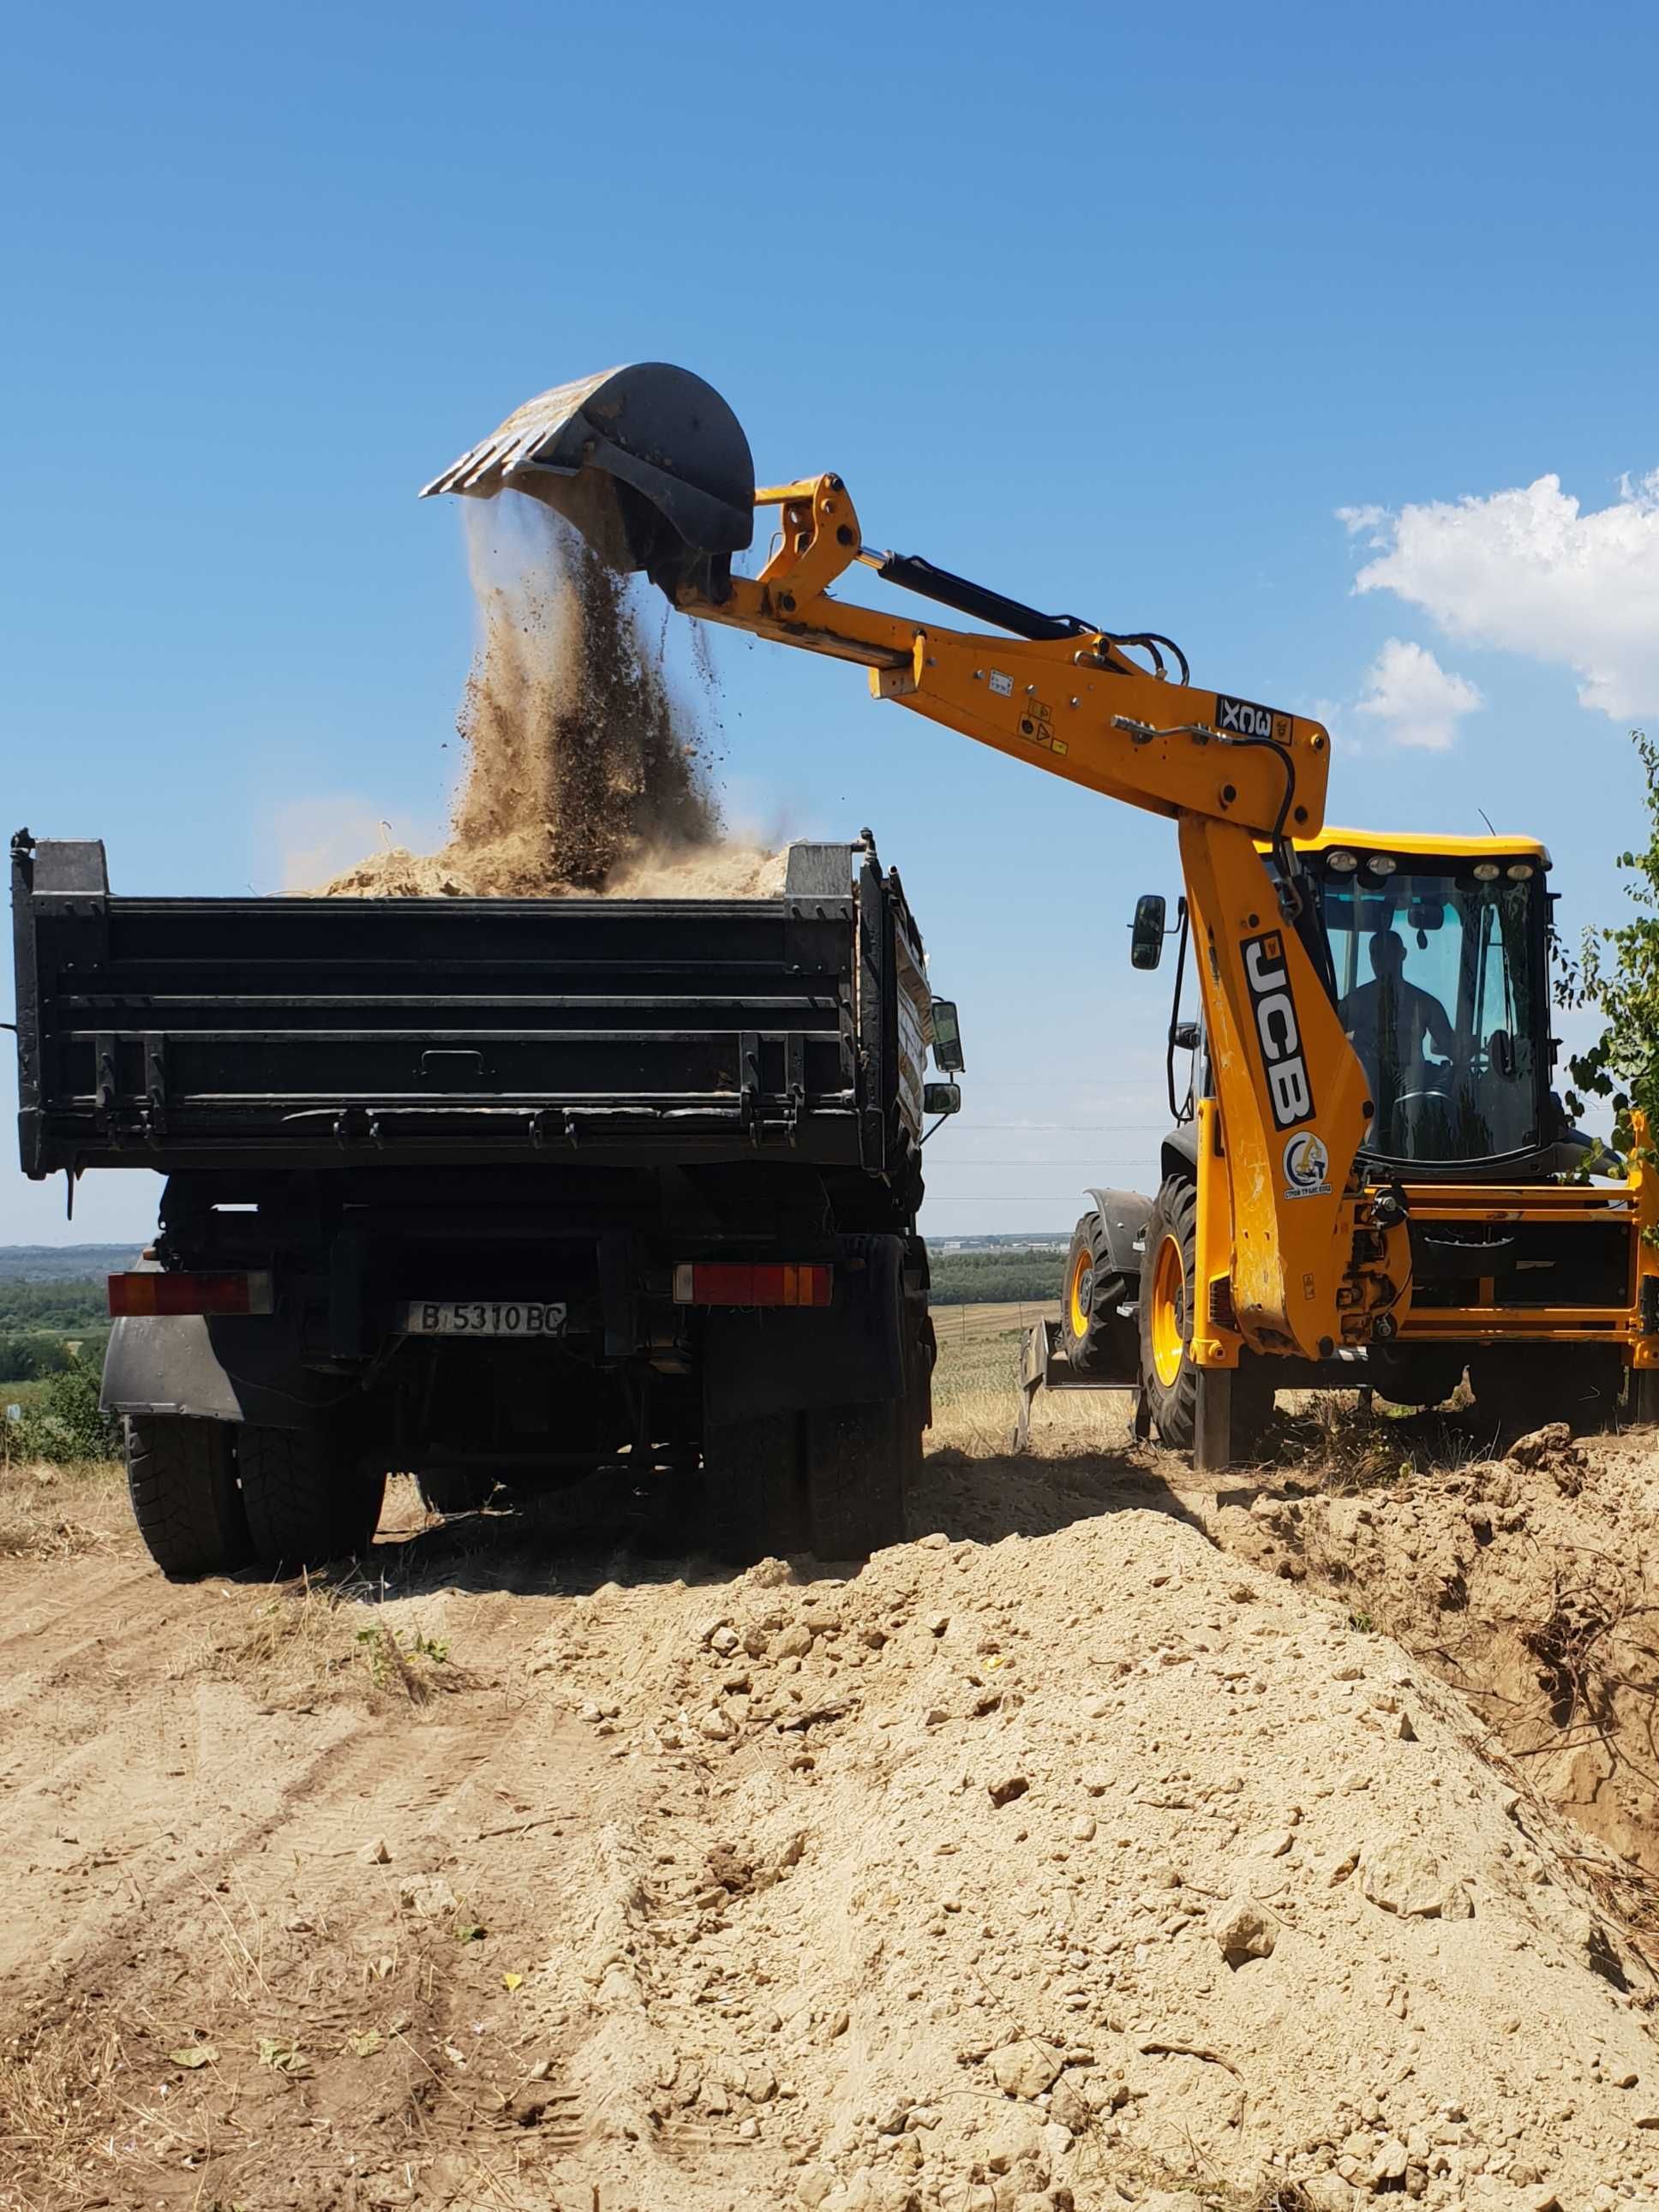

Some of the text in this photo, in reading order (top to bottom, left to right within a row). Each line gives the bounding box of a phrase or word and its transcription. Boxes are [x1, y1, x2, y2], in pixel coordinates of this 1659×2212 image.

[1222, 699, 1272, 738] 3CX
[1245, 942, 1311, 1126] JCB
[422, 1304, 439, 1329] B
[453, 1305, 520, 1330] 5310
